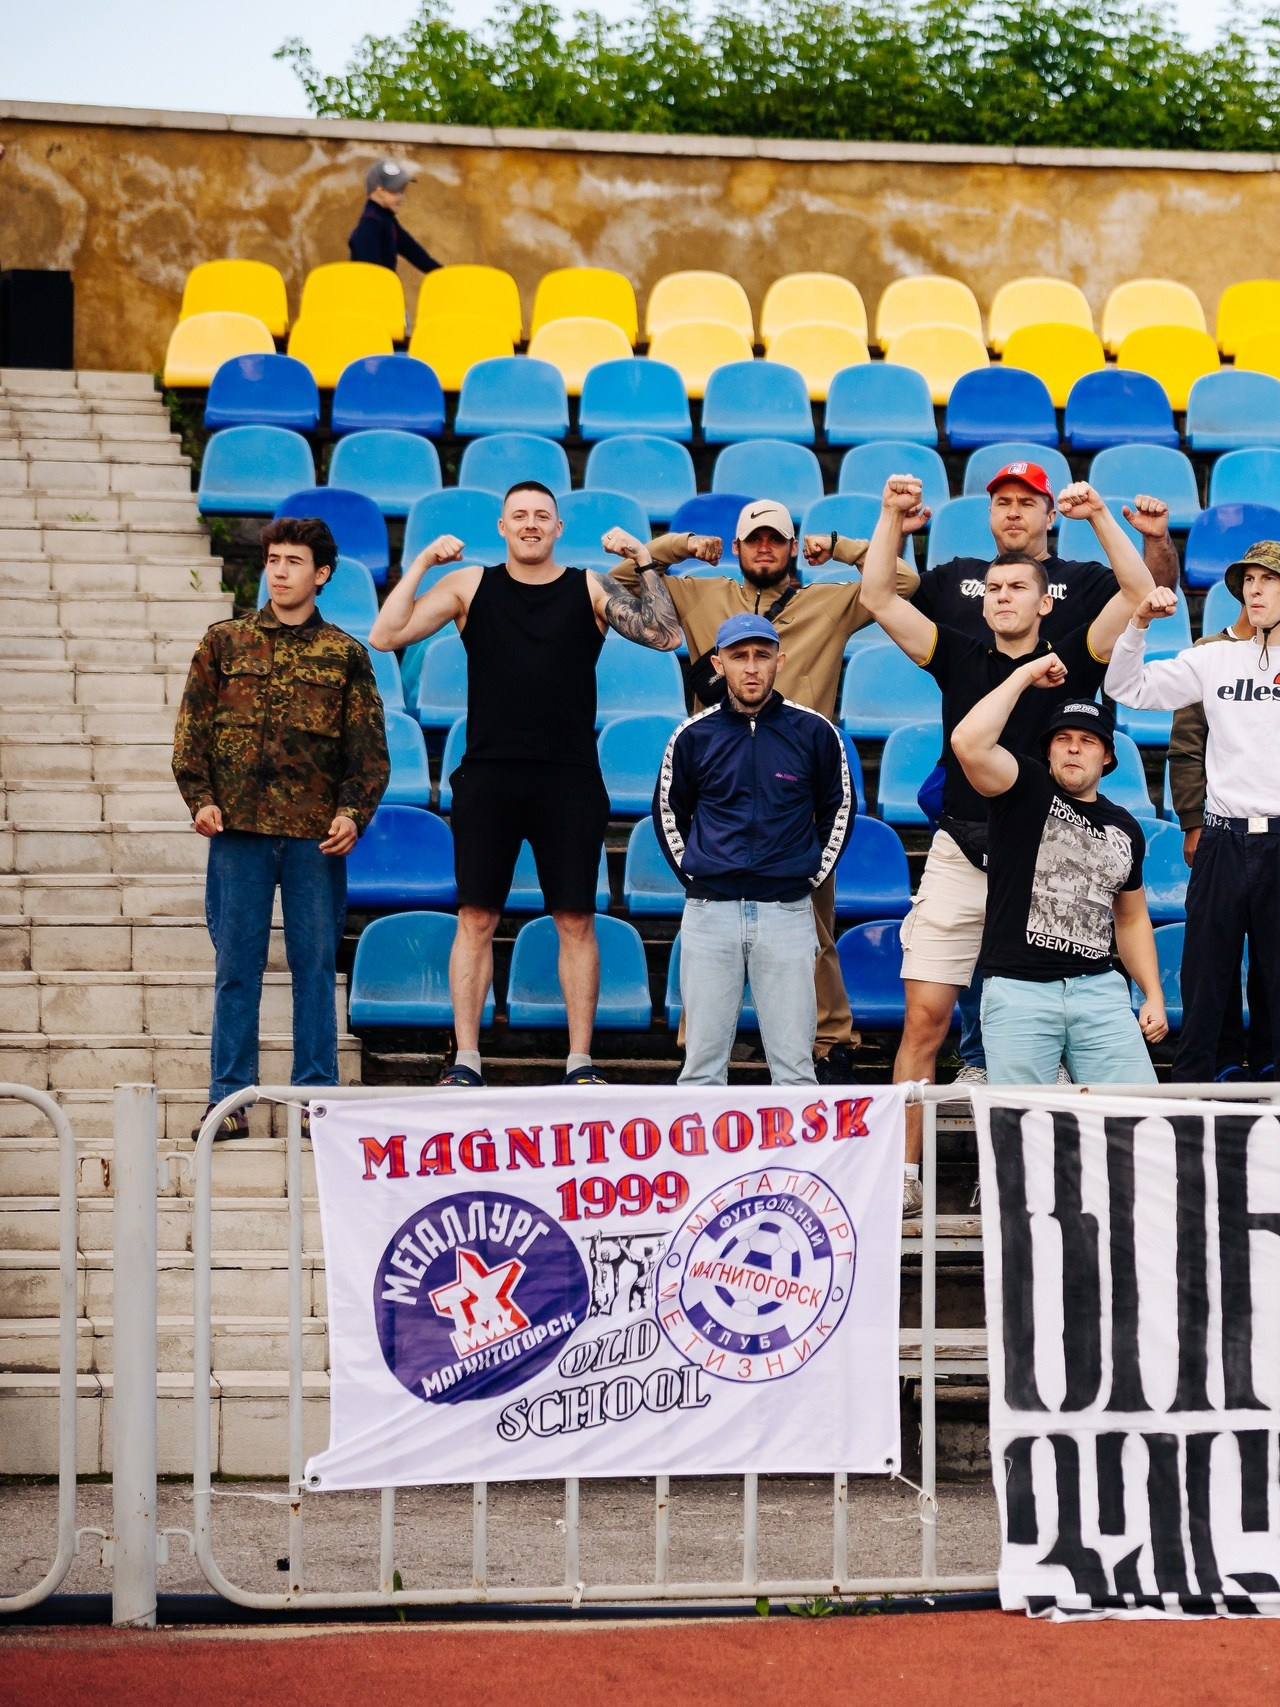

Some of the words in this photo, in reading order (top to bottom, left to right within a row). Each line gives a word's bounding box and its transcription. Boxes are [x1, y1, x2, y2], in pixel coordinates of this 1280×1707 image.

[1025, 931, 1070, 953] VSEM
[360, 1096, 874, 1181] MAGNITOGORSK
[558, 1171, 690, 1222] 1999
[686, 1173, 853, 1265] МЕТАЛЛУРГ
[719, 1197, 826, 1248] ФУТБОЛЬНЫЙ
[381, 1200, 550, 1305] МЕТАЛЛУРГ
[688, 1260, 823, 1309] МАГНИТОГОРСК
[420, 1311, 577, 1398] МАГНИТОГОРСК
[557, 1317, 662, 1379] OLD
[659, 1282, 833, 1379] МЕТИЗНИК
[702, 1319, 771, 1350] КЛУБ
[496, 1363, 712, 1443] SCHOOL
